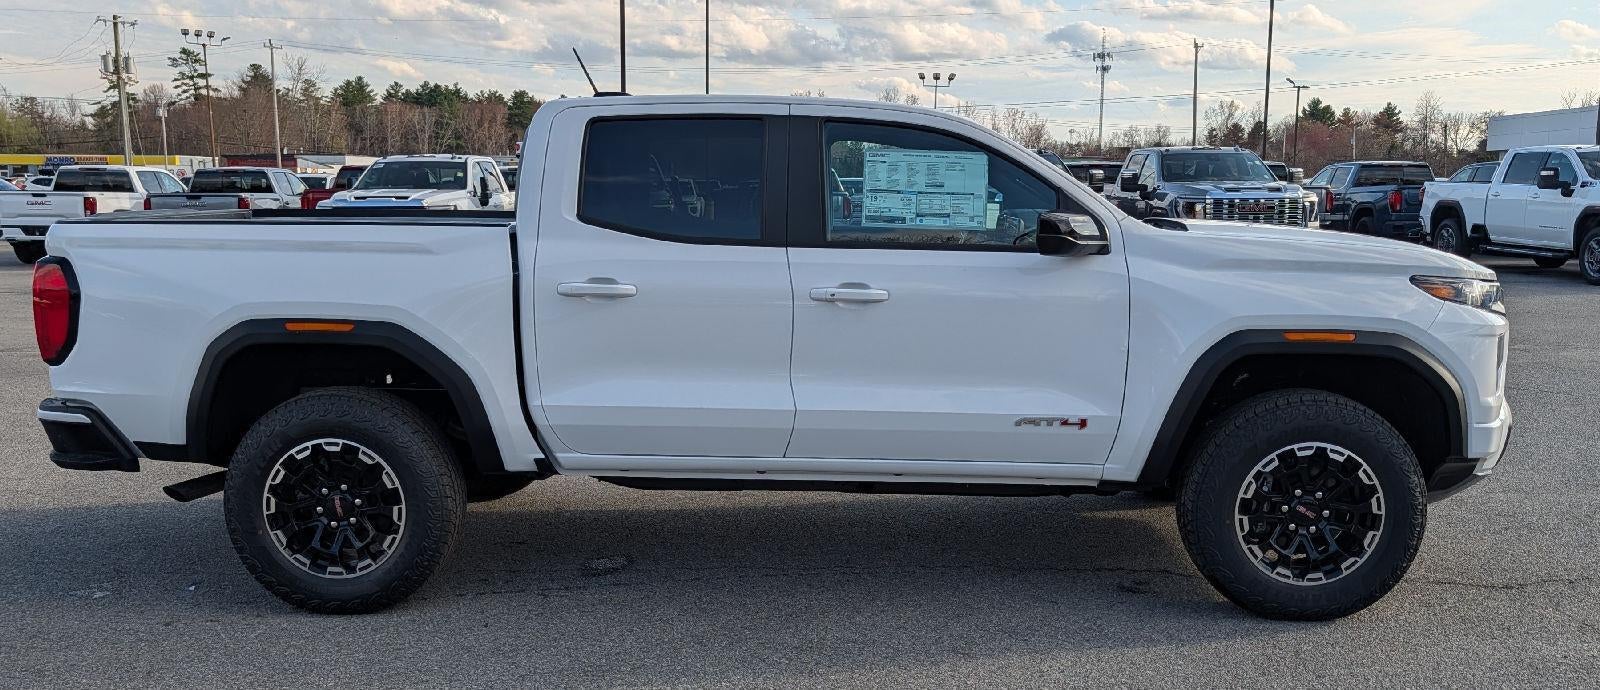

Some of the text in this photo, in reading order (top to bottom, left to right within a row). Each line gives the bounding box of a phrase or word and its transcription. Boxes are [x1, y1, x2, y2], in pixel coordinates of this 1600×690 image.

[46, 156, 75, 164] MONRO
[1238, 203, 1276, 212] GMC
[1015, 416, 1088, 430] AT4
